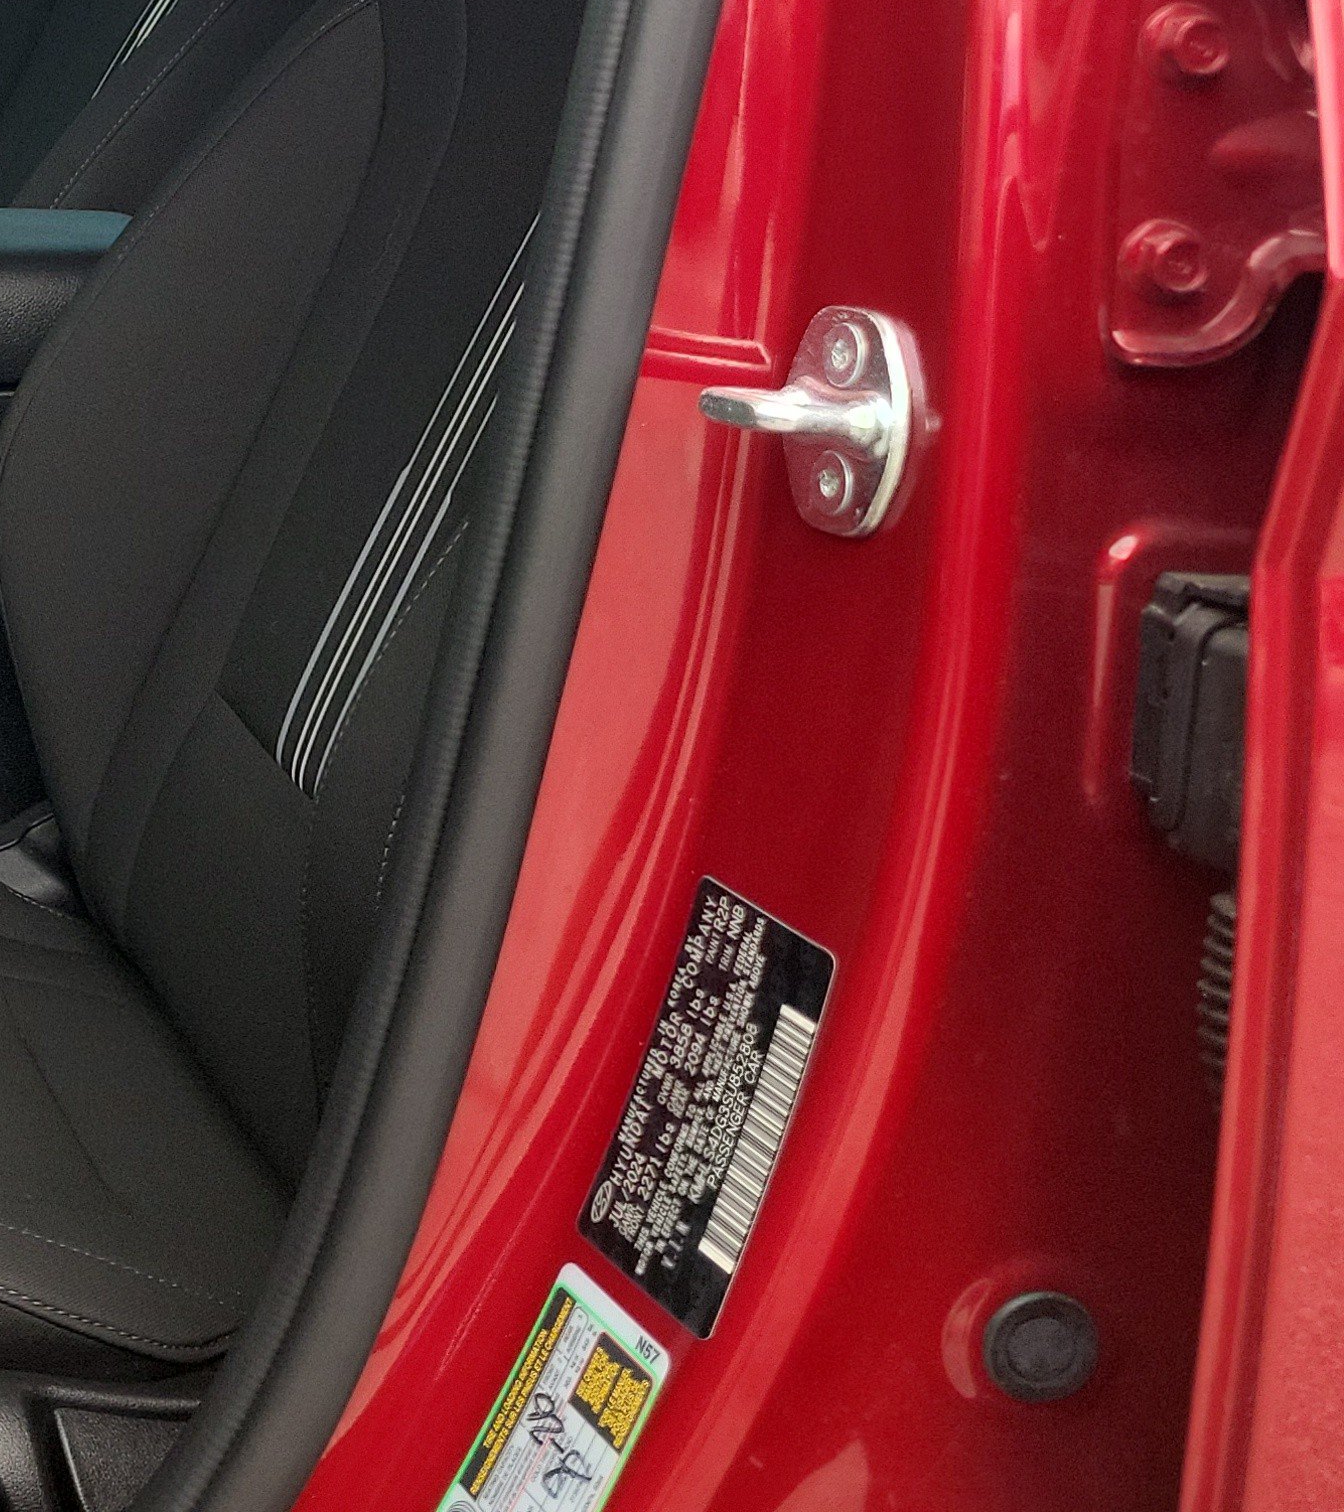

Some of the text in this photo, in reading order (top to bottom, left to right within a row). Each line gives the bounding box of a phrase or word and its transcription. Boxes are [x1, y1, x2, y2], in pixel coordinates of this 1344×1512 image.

[712, 893, 730, 932] R2P
[704, 932, 721, 964] PAINT
[732, 931, 752, 975] FEDERAL
[667, 967, 686, 1007] KOREA
[748, 952, 765, 989] ABOVE
[685, 987, 705, 1018] lbs
[608, 895, 717, 1186] HYUNDAI MOTOR COMPANY
[636, 1156, 662, 1202] 2271
[655, 1121, 676, 1153] lbs
[683, 1031, 707, 1076] 2094
[700, 994, 720, 1026] lbs
[718, 943, 733, 971] TRIM
[726, 903, 746, 940] NNB
[669, 1021, 693, 1069] 3858
[707, 1048, 764, 1189] PASSENGER CAR
[635, 1335, 661, 1365] N57
